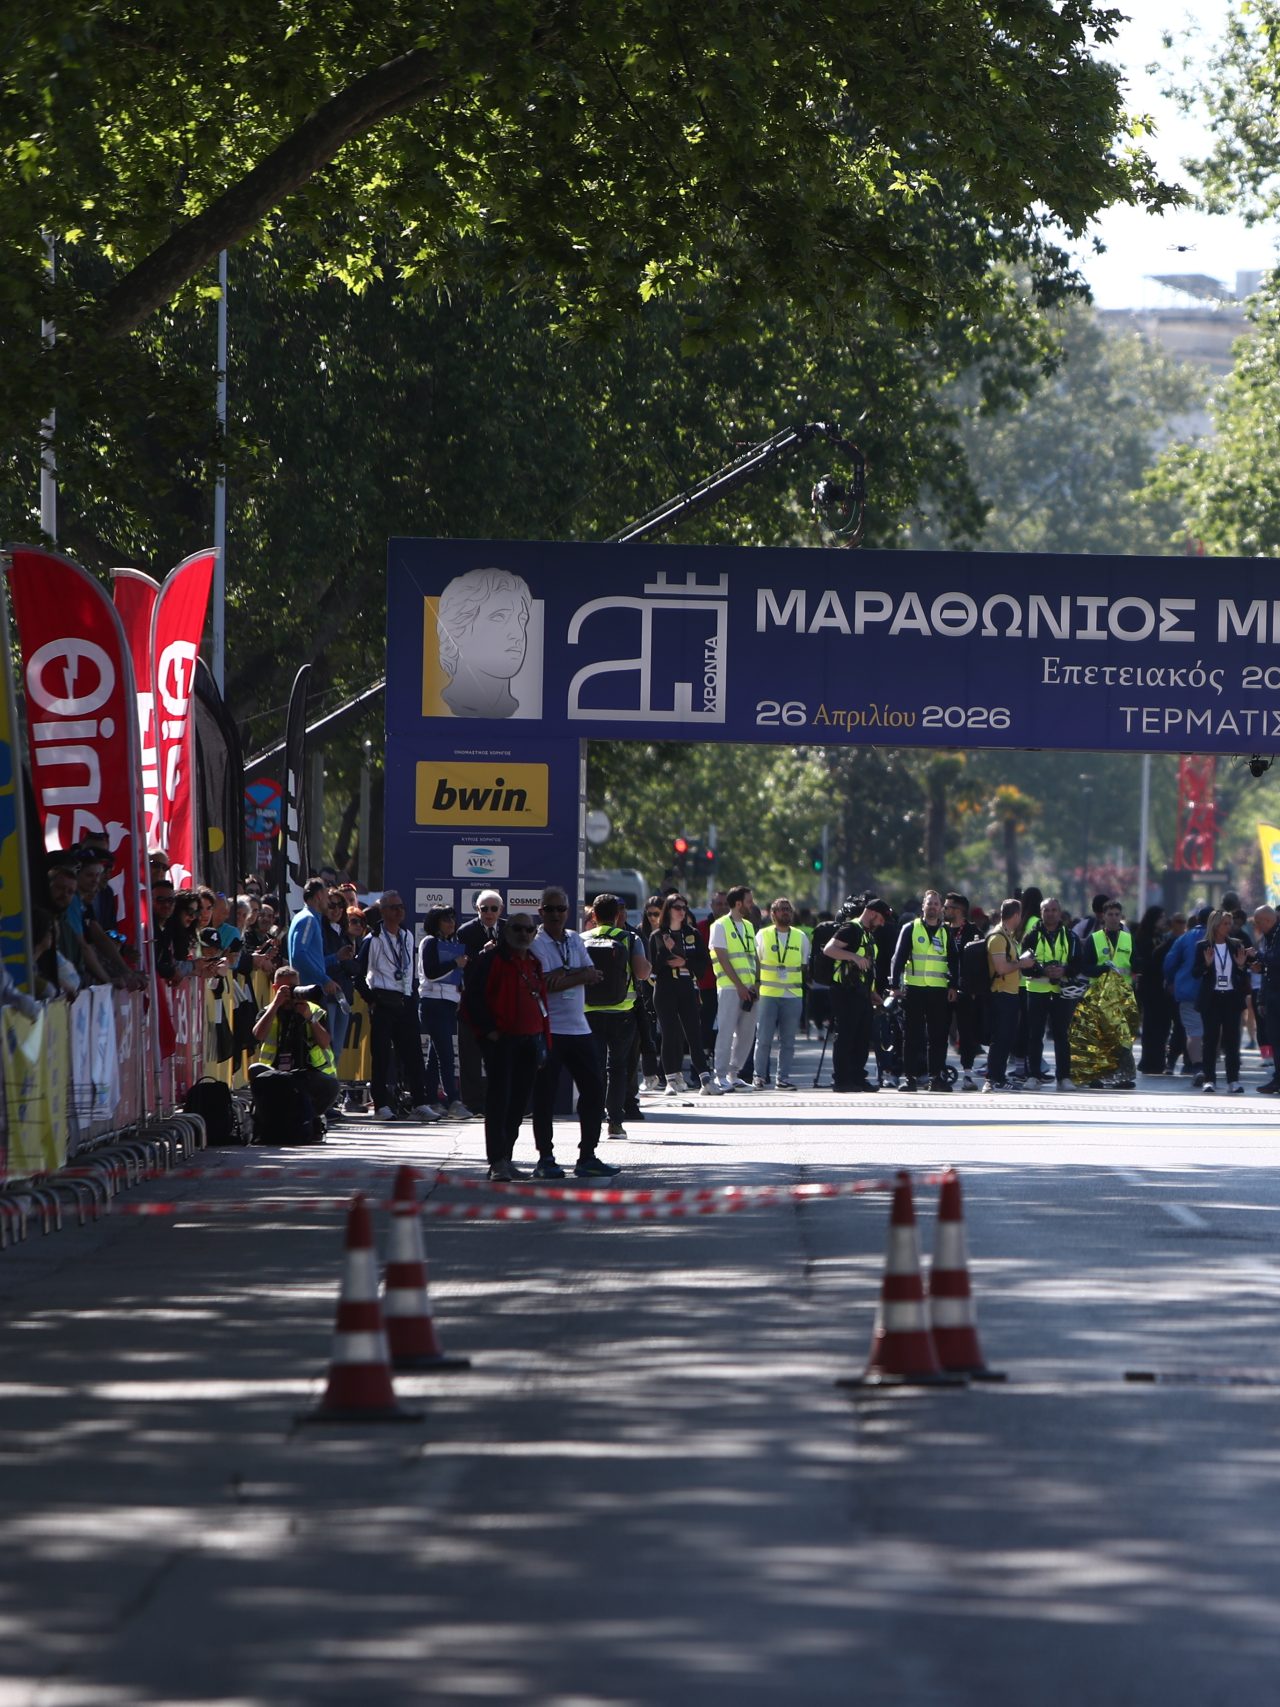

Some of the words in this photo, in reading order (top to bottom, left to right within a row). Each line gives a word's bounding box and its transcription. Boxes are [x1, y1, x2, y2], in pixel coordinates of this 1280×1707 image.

[756, 588, 1196, 642] ΜΑΡΑΘΩΝΙΟΣ
[703, 635, 718, 713] ΧΡΟΝΙΑ
[1041, 656, 1225, 695] Επετειακός
[756, 700, 807, 726] 26
[812, 703, 916, 732] Απριλίου
[922, 705, 1011, 729] 2026
[432, 777, 527, 812] bwin
[465, 858, 494, 867] ΑΥΡΑ
